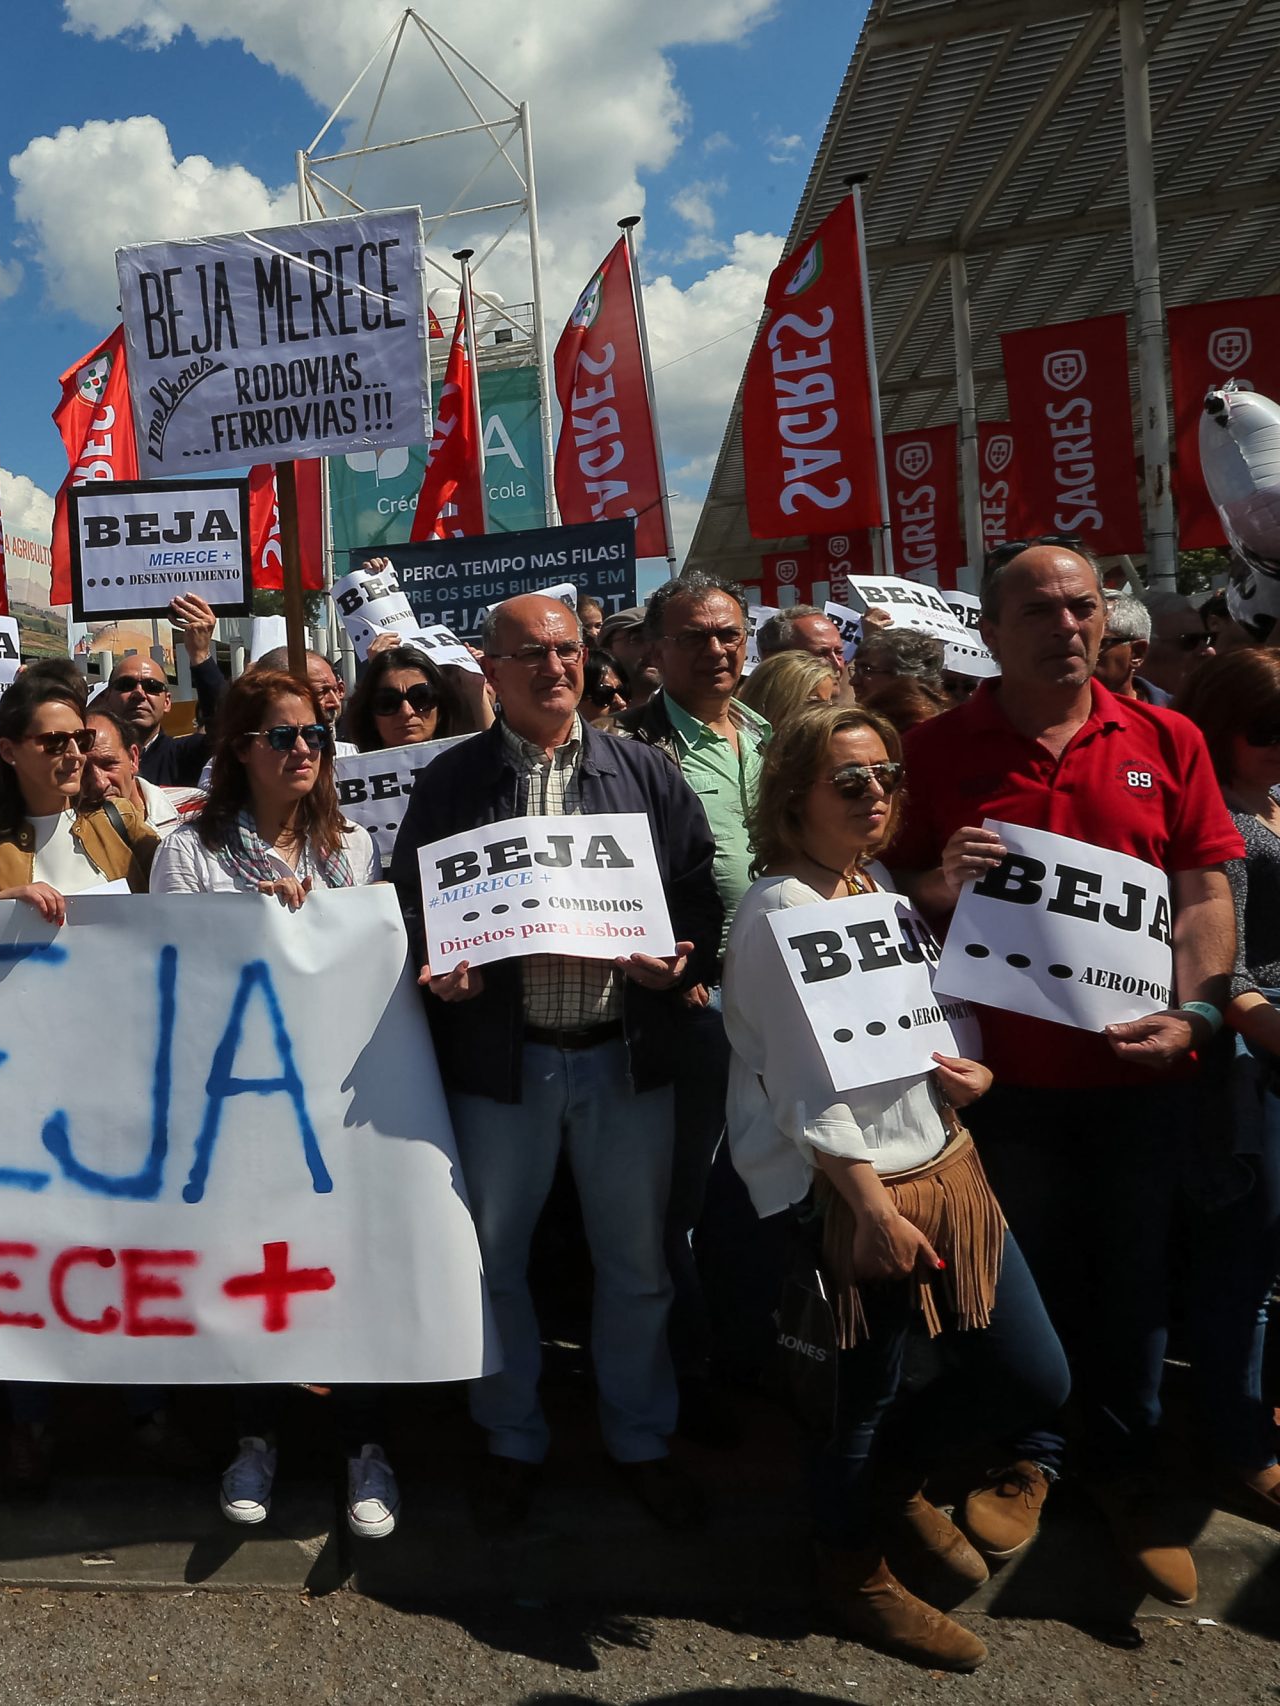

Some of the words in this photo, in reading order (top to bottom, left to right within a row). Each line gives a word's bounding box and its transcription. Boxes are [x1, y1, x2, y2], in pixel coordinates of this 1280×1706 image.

[138, 262, 239, 360] BEJA
[254, 238, 406, 347] MERECE
[1045, 397, 1104, 532] SAGRES
[486, 480, 527, 500] cola
[84, 509, 239, 548] BEJA
[149, 550, 218, 567] MERECE
[222, 551, 232, 561] +
[403, 565, 457, 583] PERCA
[462, 556, 526, 577] TEMPO
[531, 550, 567, 569] NAS
[572, 543, 626, 564] FILAS!
[129, 569, 240, 585] DESENVOLVIMENTO
[437, 586, 459, 600] OS
[462, 582, 504, 599] SEUS
[509, 572, 589, 594] BILHETES
[597, 569, 625, 585] EM
[858, 585, 952, 615] BEJA
[1127, 771, 1152, 788] 89
[435, 835, 634, 891] BEJA
[428, 871, 533, 909] #MERECE
[548, 896, 644, 913] COMBOIOS
[973, 852, 1172, 950] BEJA
[440, 926, 516, 956] Diretos
[520, 922, 569, 939] para
[575, 922, 647, 938] Lisboa
[222, 1241, 337, 1332] +
[777, 1333, 827, 1362] JONES
